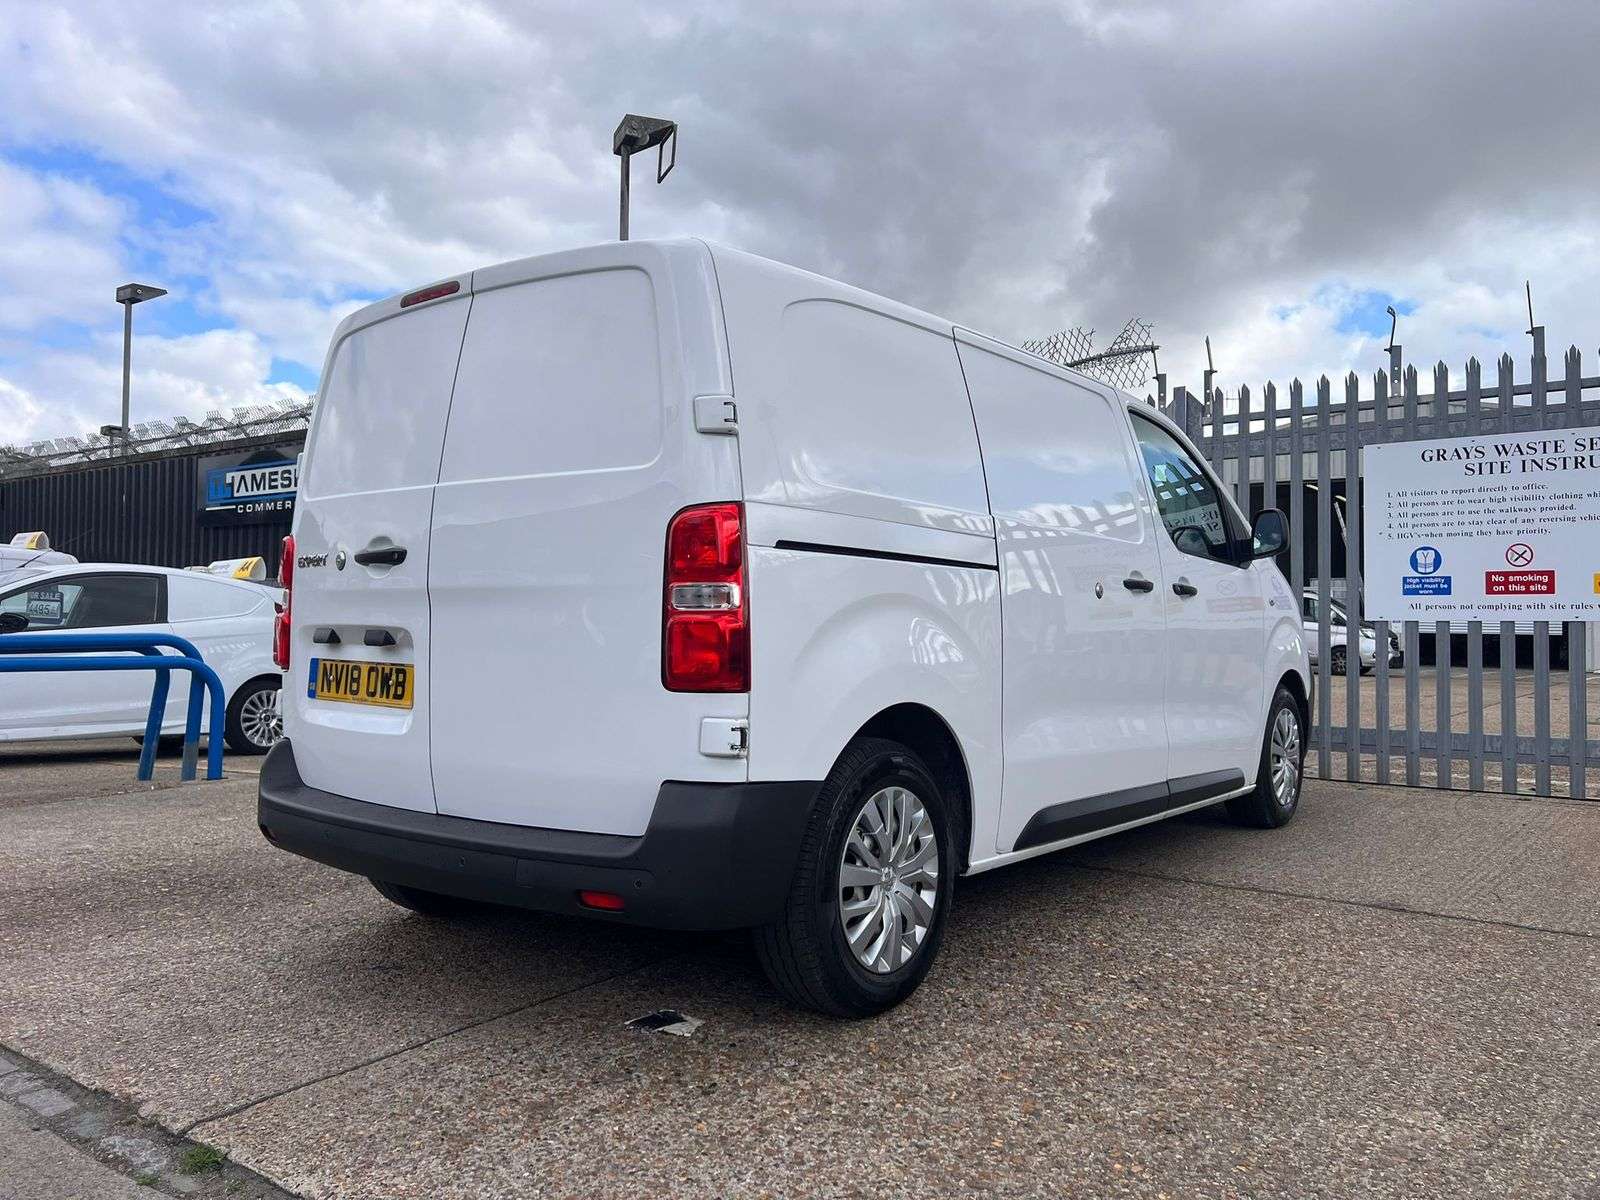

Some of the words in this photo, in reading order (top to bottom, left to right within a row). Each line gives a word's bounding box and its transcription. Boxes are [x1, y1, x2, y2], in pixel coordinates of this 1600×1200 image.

[1421, 445, 1485, 462] GRAYS
[1494, 440, 1566, 457] WASTE
[1575, 437, 1600, 452] SE
[1464, 461, 1511, 476] SITE
[1521, 455, 1600, 472] INSTRU
[1397, 490, 1407, 498] All
[1411, 489, 1438, 497] visitors
[1451, 487, 1475, 495] report
[1478, 485, 1508, 493] directly
[1522, 483, 1548, 491] office.
[237, 500, 292, 513] COMMER
[1411, 500, 1439, 508] persons
[1489, 496, 1507, 504] high
[1510, 494, 1545, 502] visibility
[1549, 491, 1583, 500] clothing
[1411, 511, 1439, 519] persons
[1457, 508, 1465, 516] to
[1499, 506, 1537, 514] walkways
[1540, 504, 1577, 513] provided.
[1411, 522, 1439, 530] persons
[1468, 519, 1483, 527] stay
[1540, 515, 1577, 523] reversing
[1447, 530, 1474, 538] moving
[1476, 529, 1492, 537] they
[1517, 527, 1551, 536] priority.
[1491, 574, 1504, 582] No
[1508, 573, 1549, 582] smoking
[1508, 583, 1526, 591] this
[1529, 583, 1547, 591] site
[1425, 603, 1457, 611] persons
[1477, 602, 1522, 611] complying
[1526, 602, 1546, 610] with
[1549, 602, 1566, 610] site
[1570, 602, 1594, 610] rules
[320, 662, 361, 696] NV18
[366, 665, 407, 700] OWB
